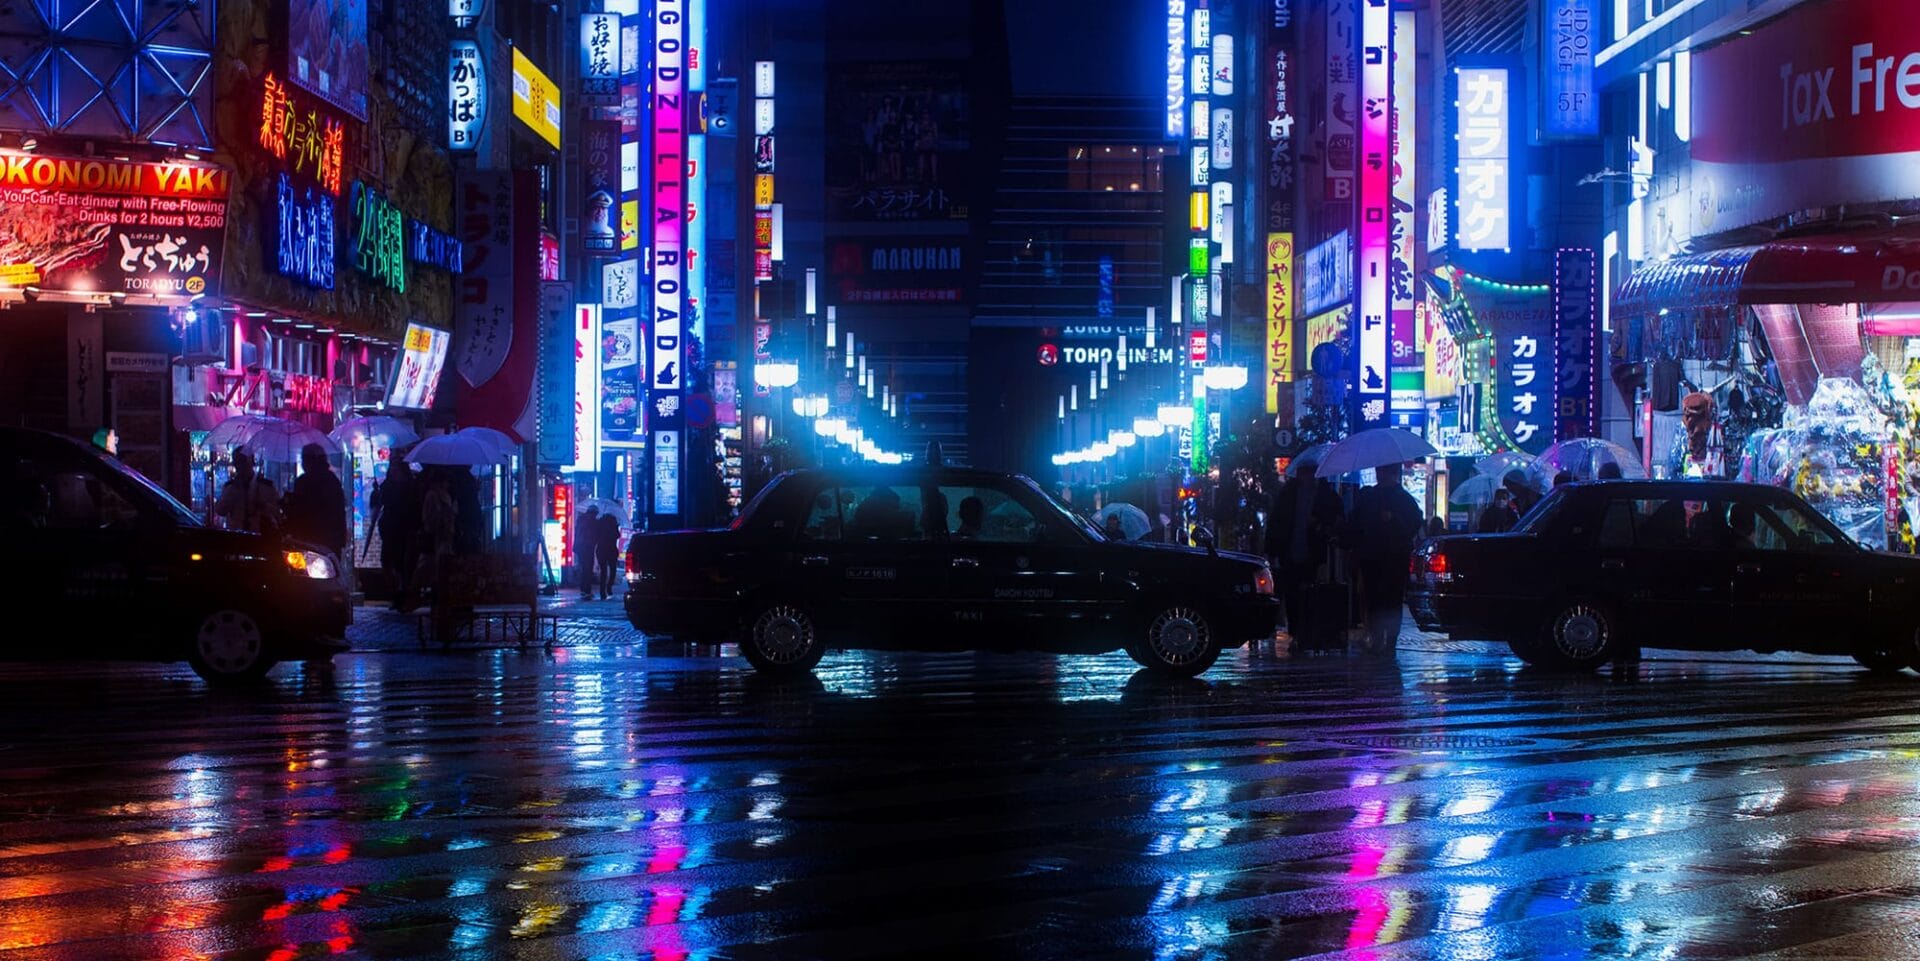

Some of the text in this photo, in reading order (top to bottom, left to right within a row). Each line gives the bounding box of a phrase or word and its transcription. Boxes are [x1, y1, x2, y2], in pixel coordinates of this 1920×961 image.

[454, 17, 473, 28] 1F
[1574, 9, 1588, 61] IDOL
[590, 16, 611, 77] お好み焼
[1558, 8, 1573, 72] STAGE
[451, 60, 477, 122] かっぱ
[1558, 92, 1586, 111] 5F
[1780, 62, 1835, 130] Tax
[454, 130, 473, 142] B1
[1465, 74, 1505, 243] カラオケ
[154, 164, 227, 193] YAKI
[656, 11, 680, 350] GODZILLA ROAD
[1365, 46, 1387, 330] ゴジラロード
[79, 210, 117, 223] Drinks
[120, 211, 137, 224] for
[140, 212, 147, 224] 2
[150, 212, 184, 226] hours
[80, 195, 119, 209] dinner
[123, 198, 147, 210] with
[150, 199, 225, 214] Free-Flowing
[1270, 202, 1290, 214] 4F
[1270, 215, 1290, 228] 3F
[119, 233, 210, 273] とらぢゅう
[872, 247, 961, 271] MARUHAN
[125, 277, 204, 291] TORADYU 2F
[1560, 258, 1588, 388] カラオケ
[1063, 347, 1112, 363] TOHO
[1511, 335, 1539, 443] カラオケ
[1560, 396, 1587, 416] B1
